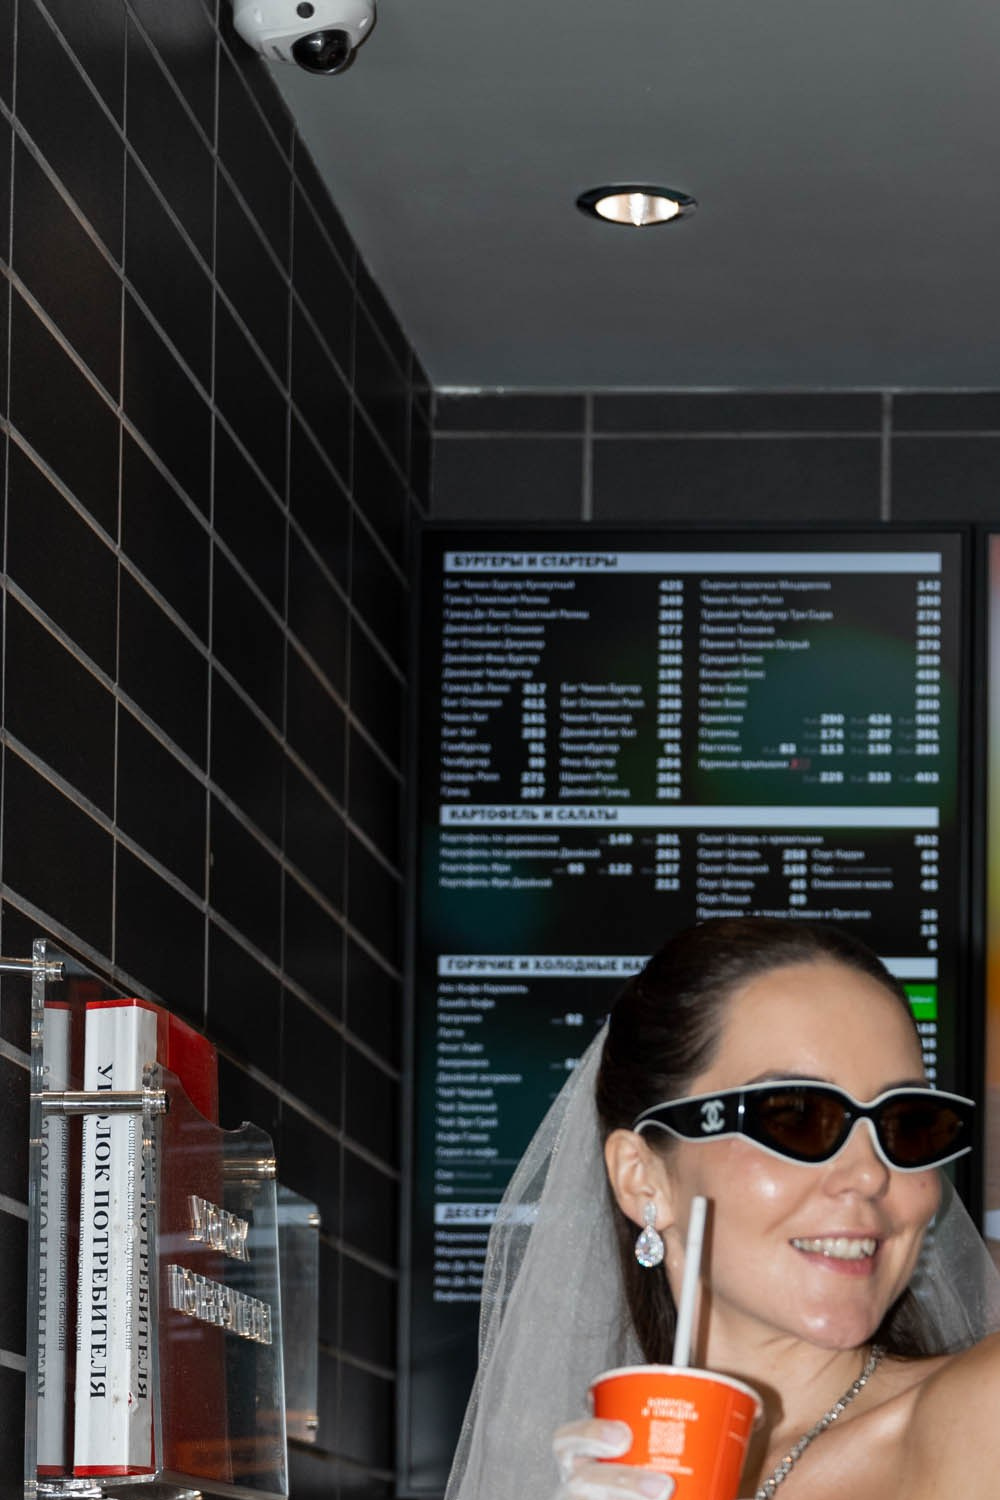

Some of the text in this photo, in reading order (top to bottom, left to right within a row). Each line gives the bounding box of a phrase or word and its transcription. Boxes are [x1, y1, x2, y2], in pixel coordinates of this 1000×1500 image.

[453, 556, 523, 567] БУРГЕРЫ
[541, 556, 618, 567] СТАРТЕРЫ
[450, 809, 539, 820] КАРТОФЕЛЬ
[557, 809, 618, 820] САЛАТЫ
[90, 1063, 114, 1399] УЛОК ПОТРЕБИТЕЛЯ
